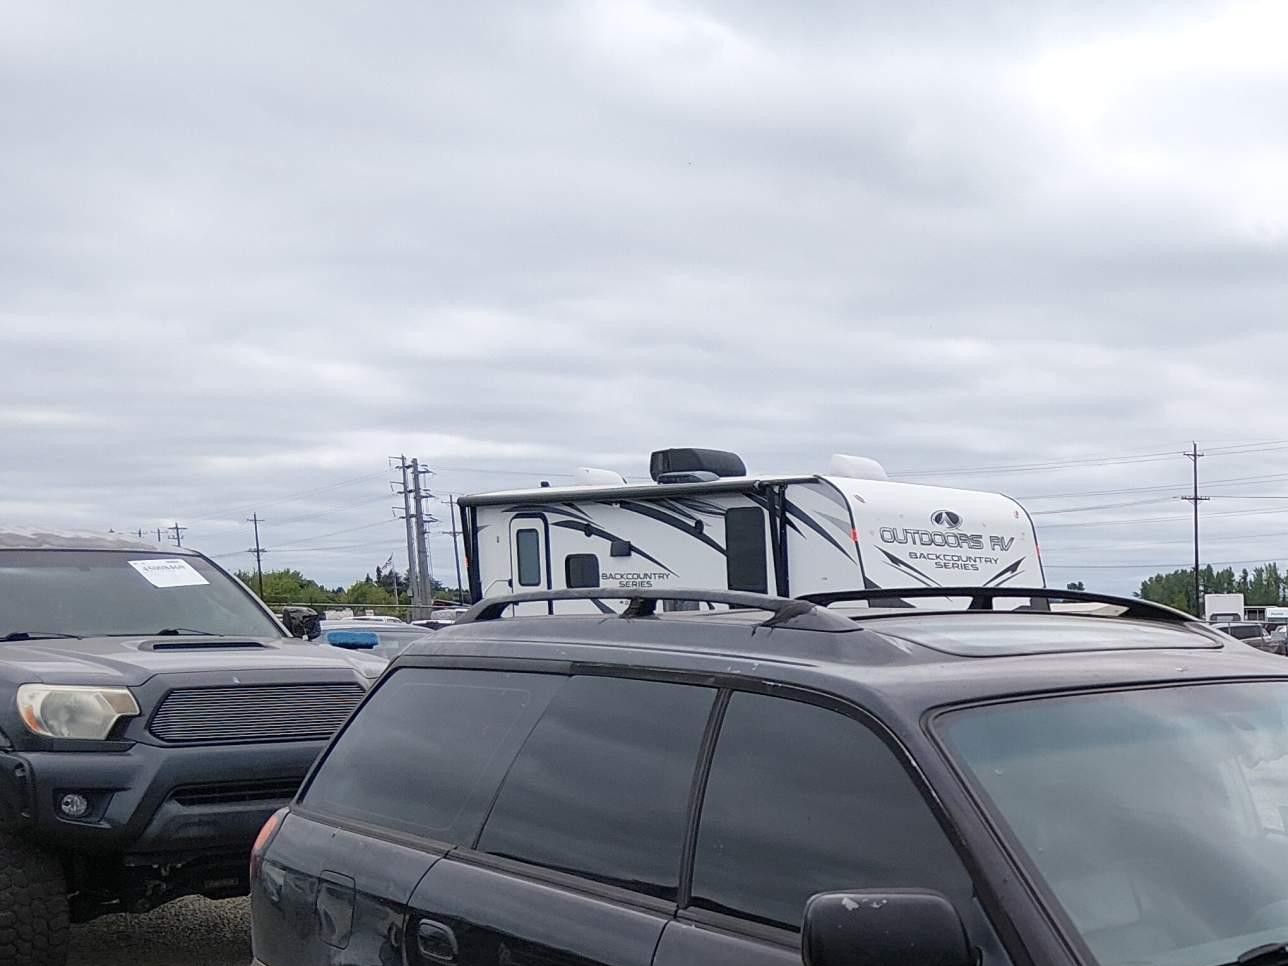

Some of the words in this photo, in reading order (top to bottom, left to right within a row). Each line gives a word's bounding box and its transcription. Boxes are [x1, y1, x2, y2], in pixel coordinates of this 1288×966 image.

[879, 527, 984, 549] OUTDOORS
[989, 536, 1016, 552] RV
[908, 552, 999, 565] BACKCOUNTRY
[934, 561, 979, 572] SERIES
[601, 573, 670, 582] BACKCOUNTRY
[619, 580, 653, 588] SERIES
